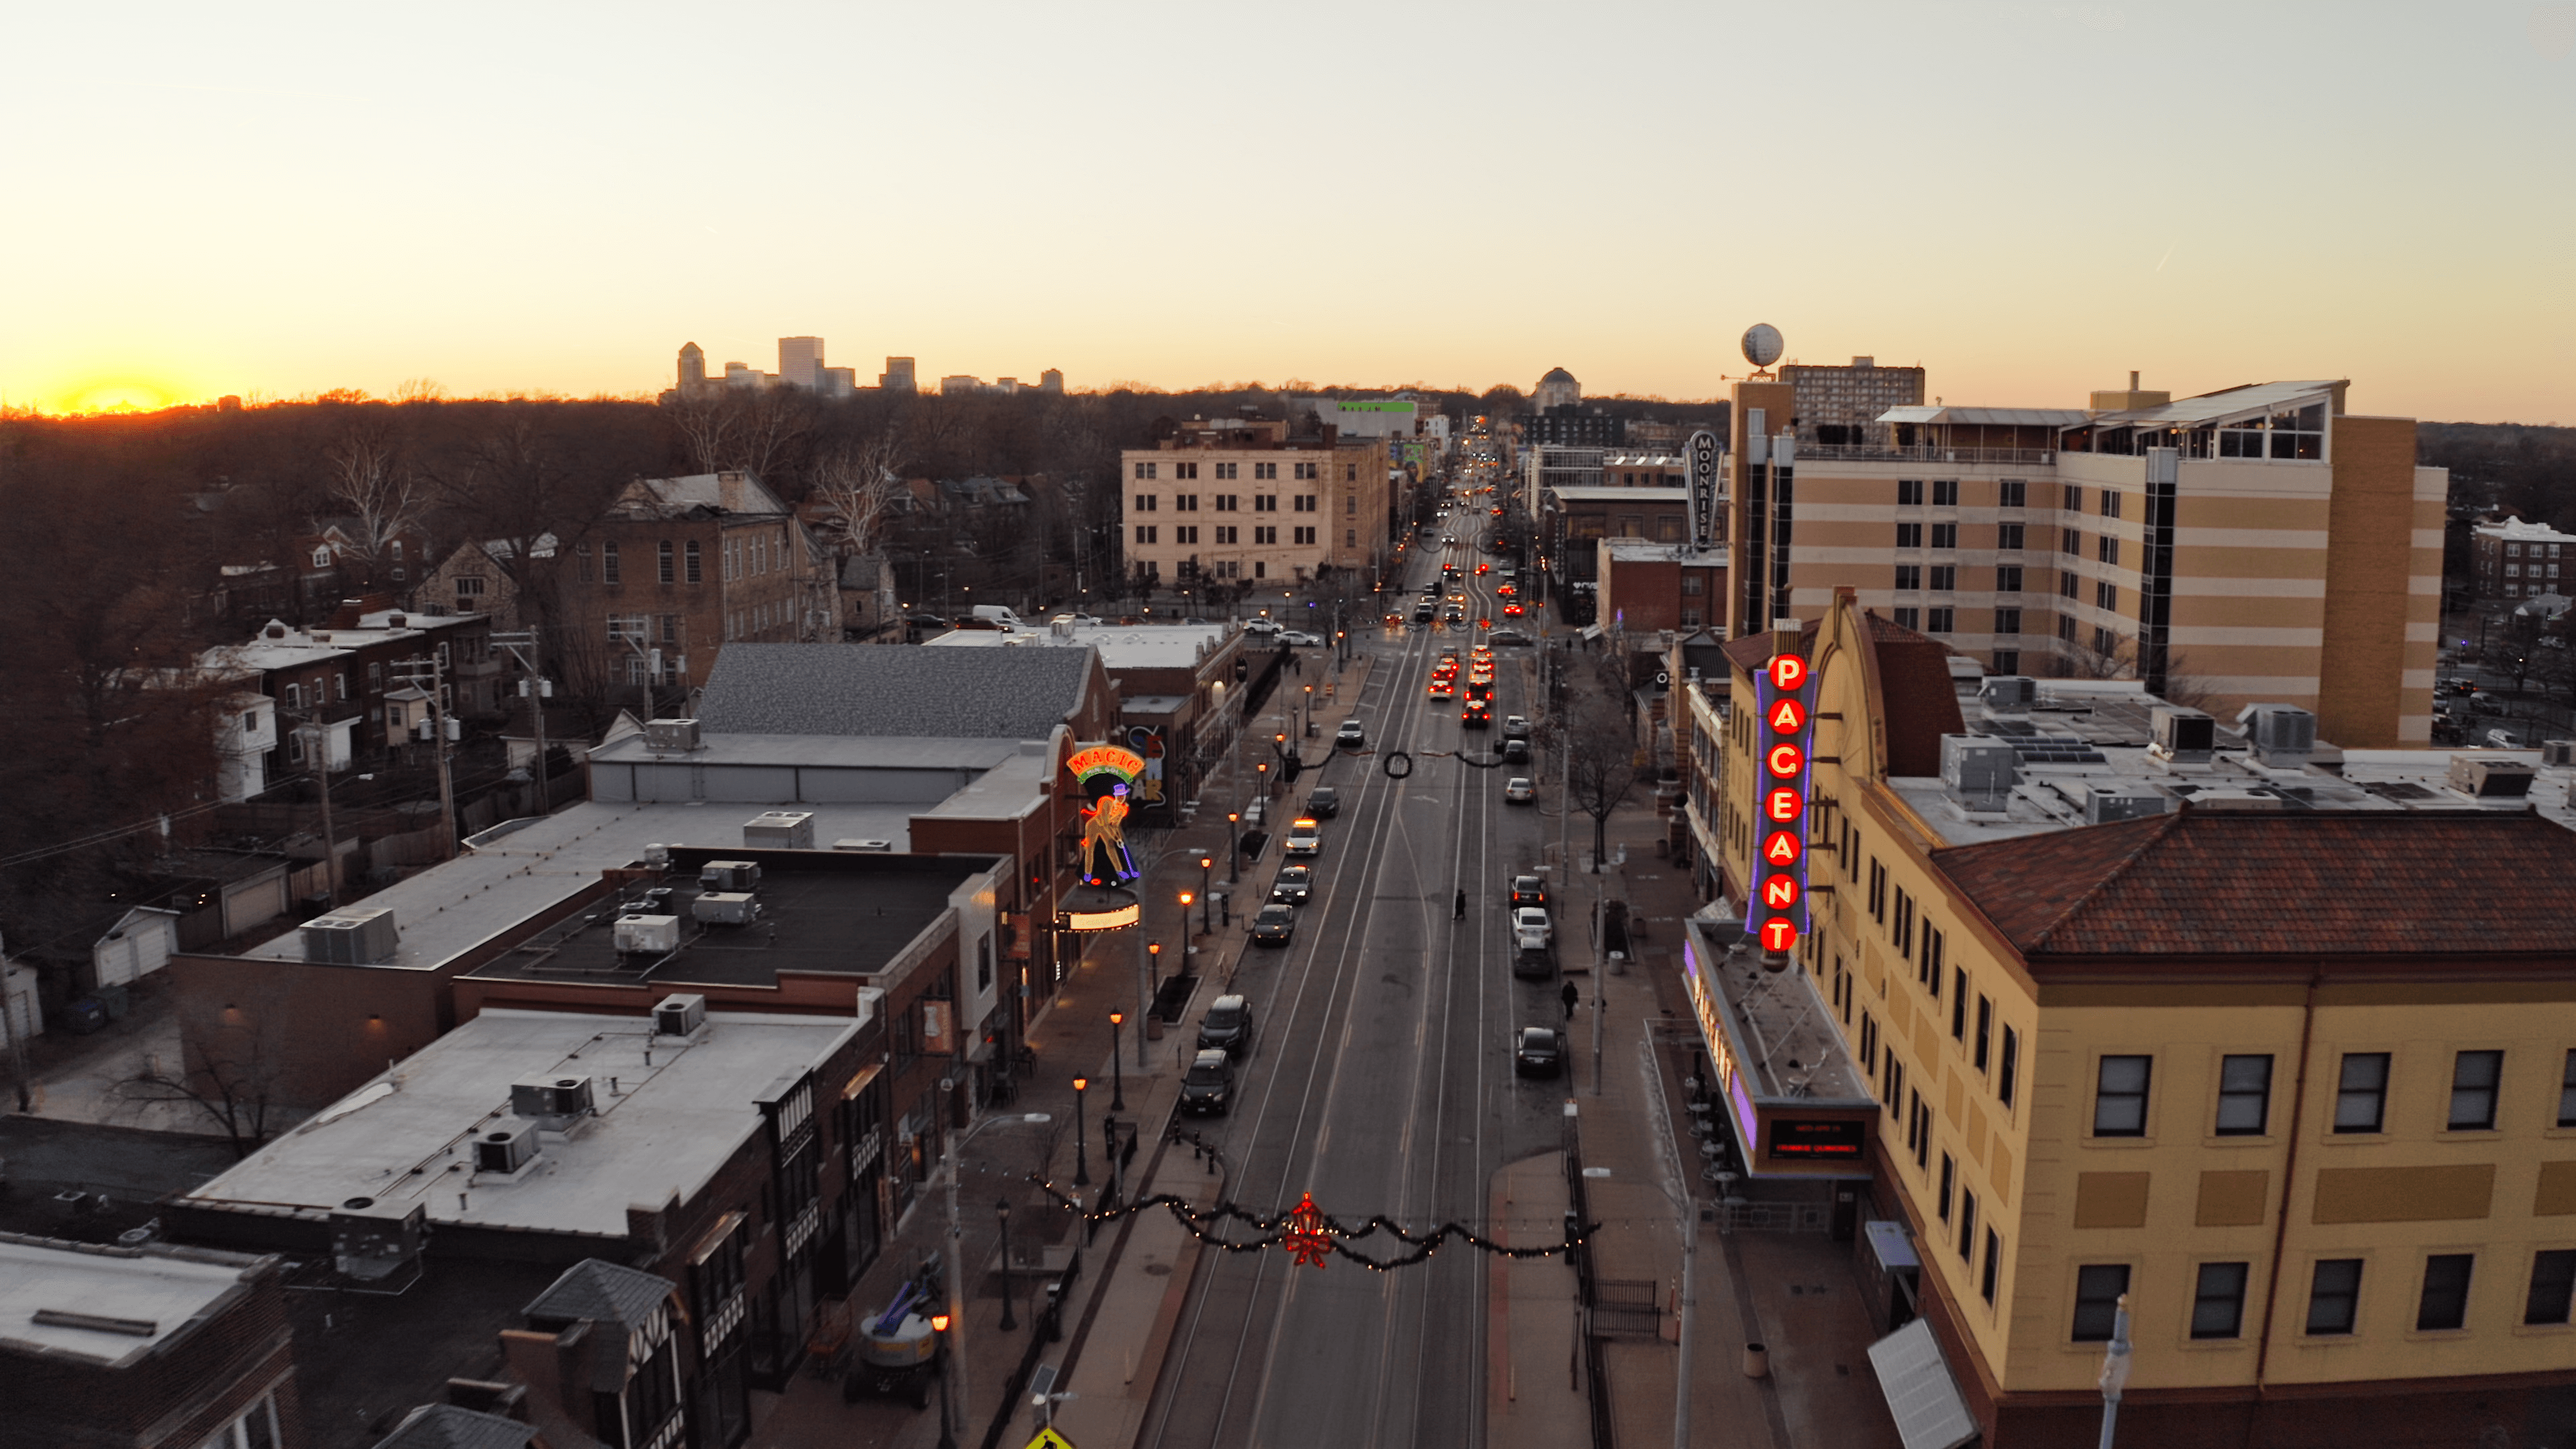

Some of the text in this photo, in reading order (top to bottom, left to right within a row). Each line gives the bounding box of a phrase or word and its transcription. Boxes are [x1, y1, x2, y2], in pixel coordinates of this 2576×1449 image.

[1697, 437, 1712, 536] MOONRISE
[1072, 750, 1140, 775] MAGIC
[1768, 659, 1801, 950] PAGEANT
